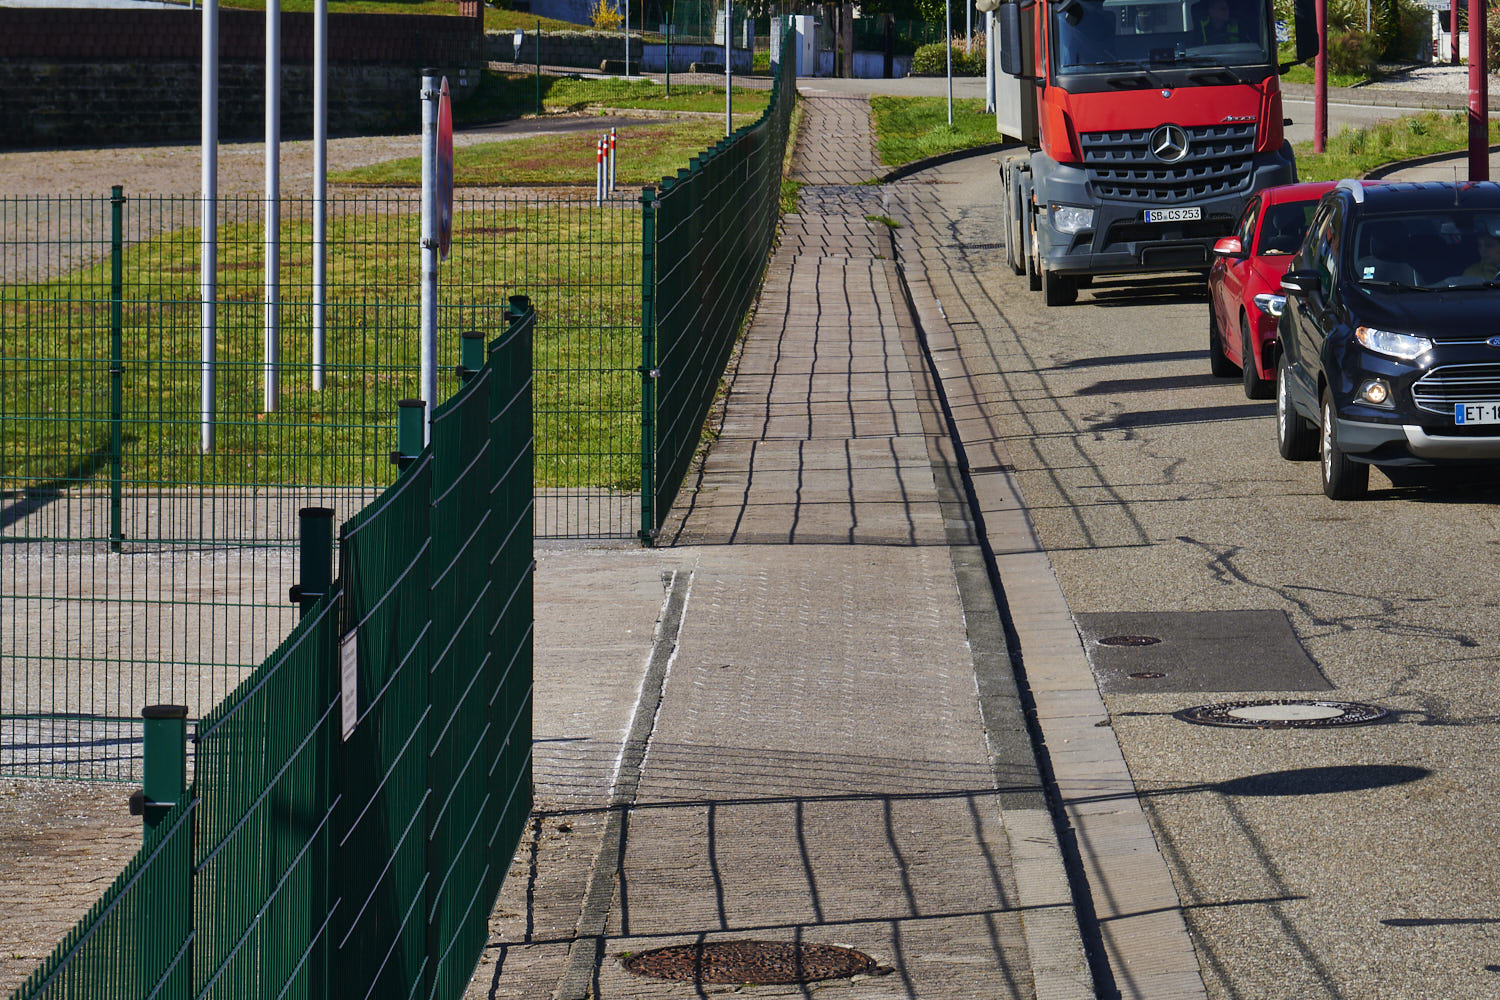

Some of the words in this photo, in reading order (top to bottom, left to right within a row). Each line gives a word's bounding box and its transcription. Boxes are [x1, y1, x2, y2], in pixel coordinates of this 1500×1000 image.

[1151, 211, 1163, 221] SB
[1168, 210, 1181, 220] CS
[1182, 209, 1200, 219] 253
